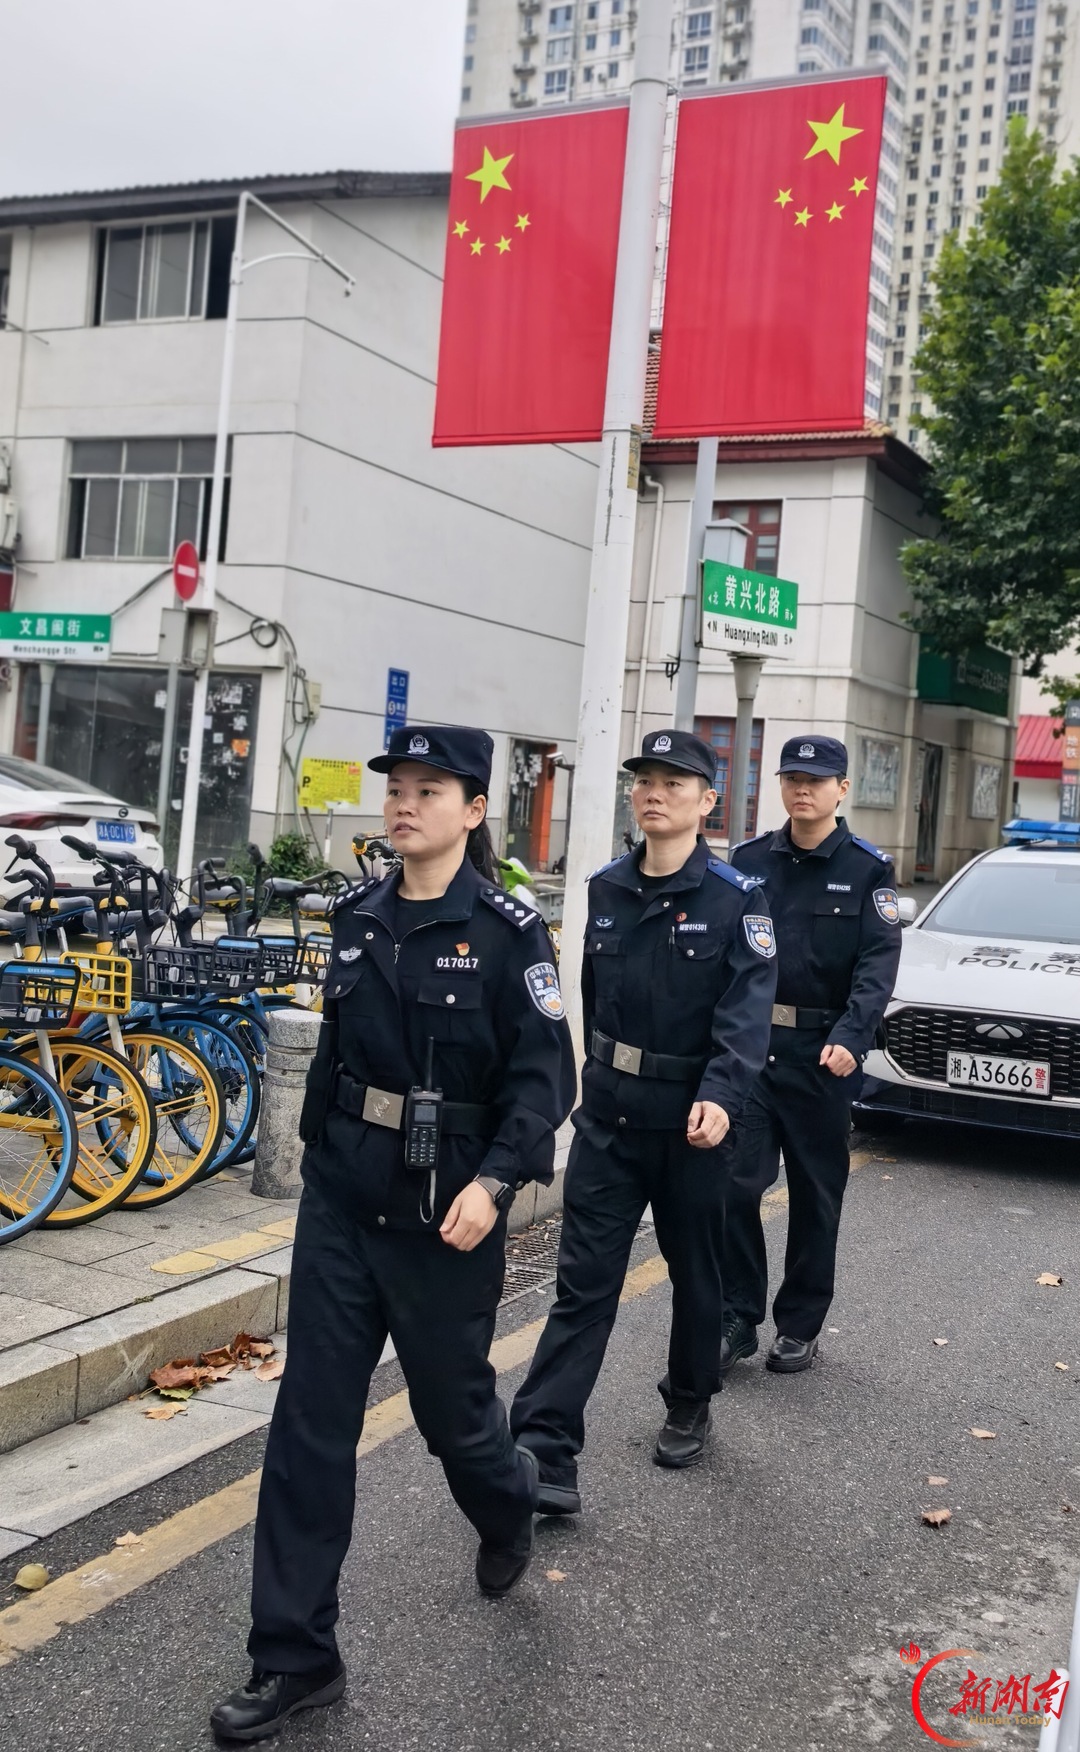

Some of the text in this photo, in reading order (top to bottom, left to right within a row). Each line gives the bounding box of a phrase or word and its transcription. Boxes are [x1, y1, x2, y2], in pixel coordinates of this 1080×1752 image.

[724, 574, 780, 619] 黄兴北路
[19, 616, 81, 638] 文昌阁街
[712, 621, 718, 633] N
[724, 623, 761, 649] Huangxing
[436, 957, 479, 969] 017017
[957, 956, 1080, 977] POLICE
